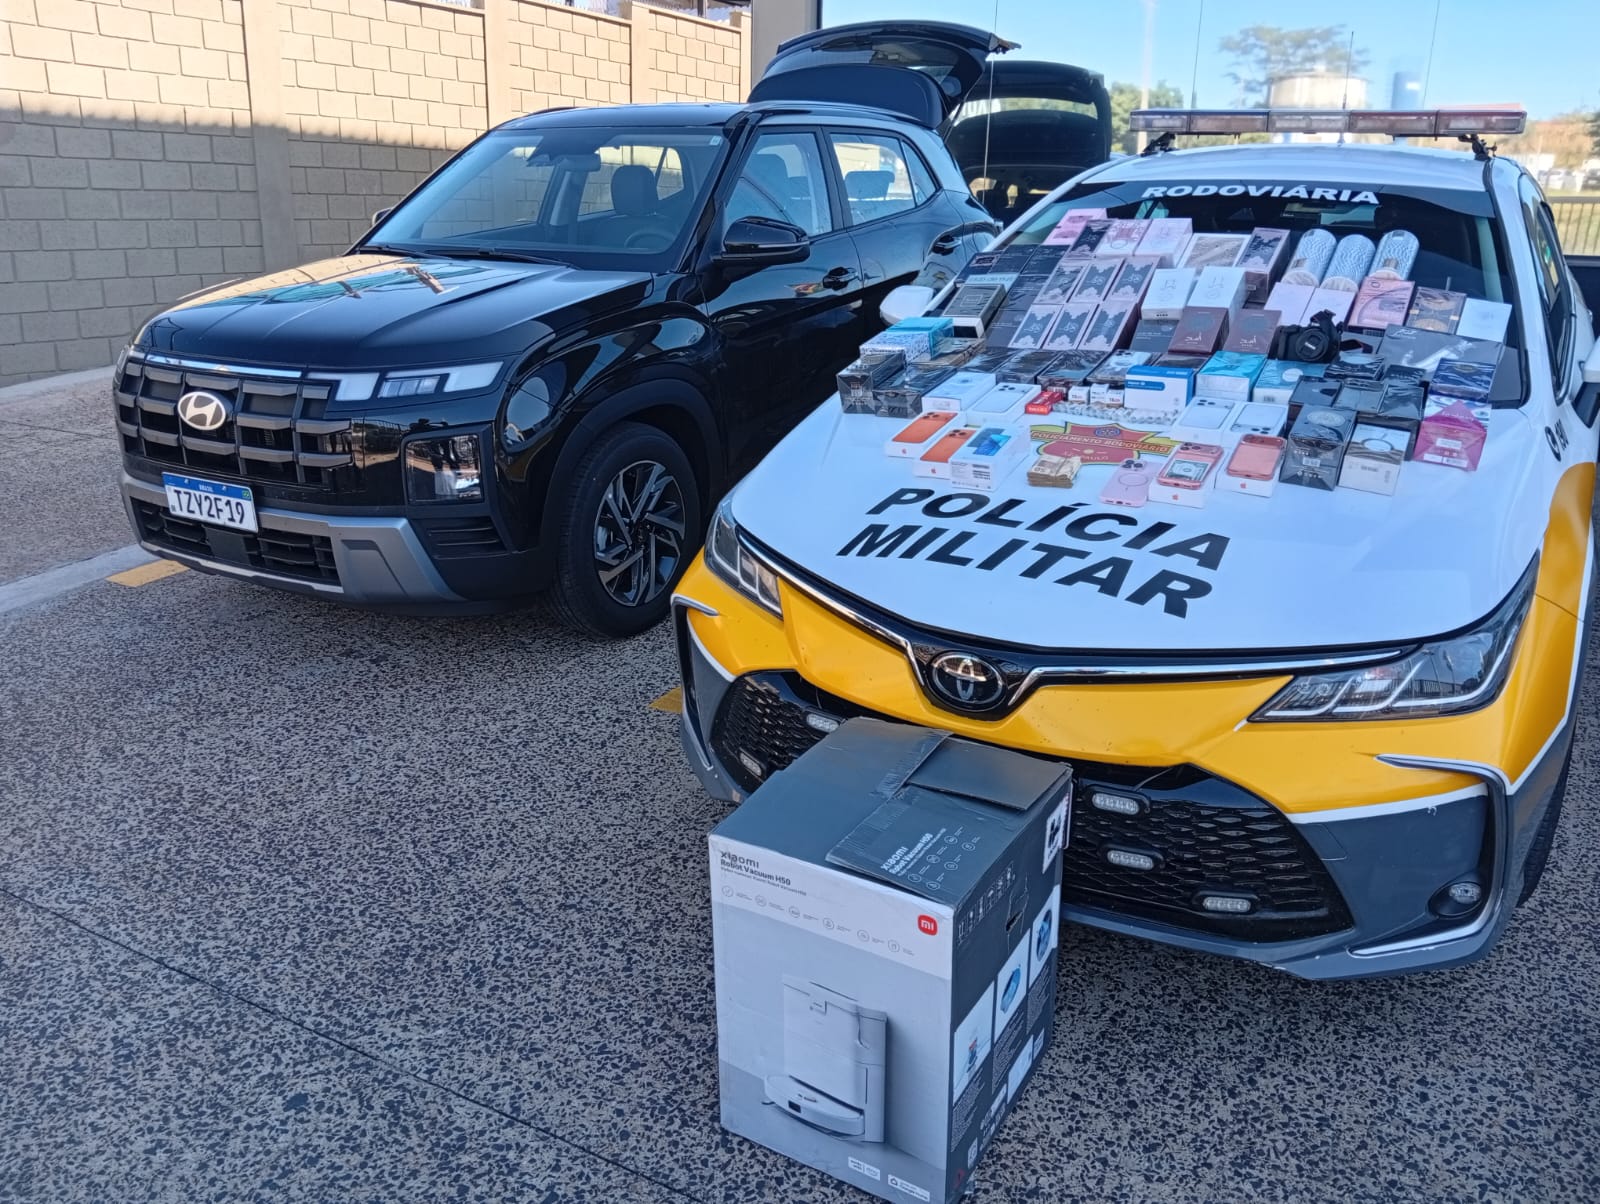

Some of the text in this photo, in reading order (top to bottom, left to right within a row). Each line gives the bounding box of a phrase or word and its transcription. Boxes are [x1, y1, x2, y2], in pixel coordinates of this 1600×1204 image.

[1141, 184, 1380, 205] RODOVIÁRIA
[173, 489, 245, 524] TZY2F19
[865, 488, 1231, 571] POLÍCIA
[835, 523, 1213, 619] MILITAR
[720, 859, 791, 886] Robot Vacuum H50
